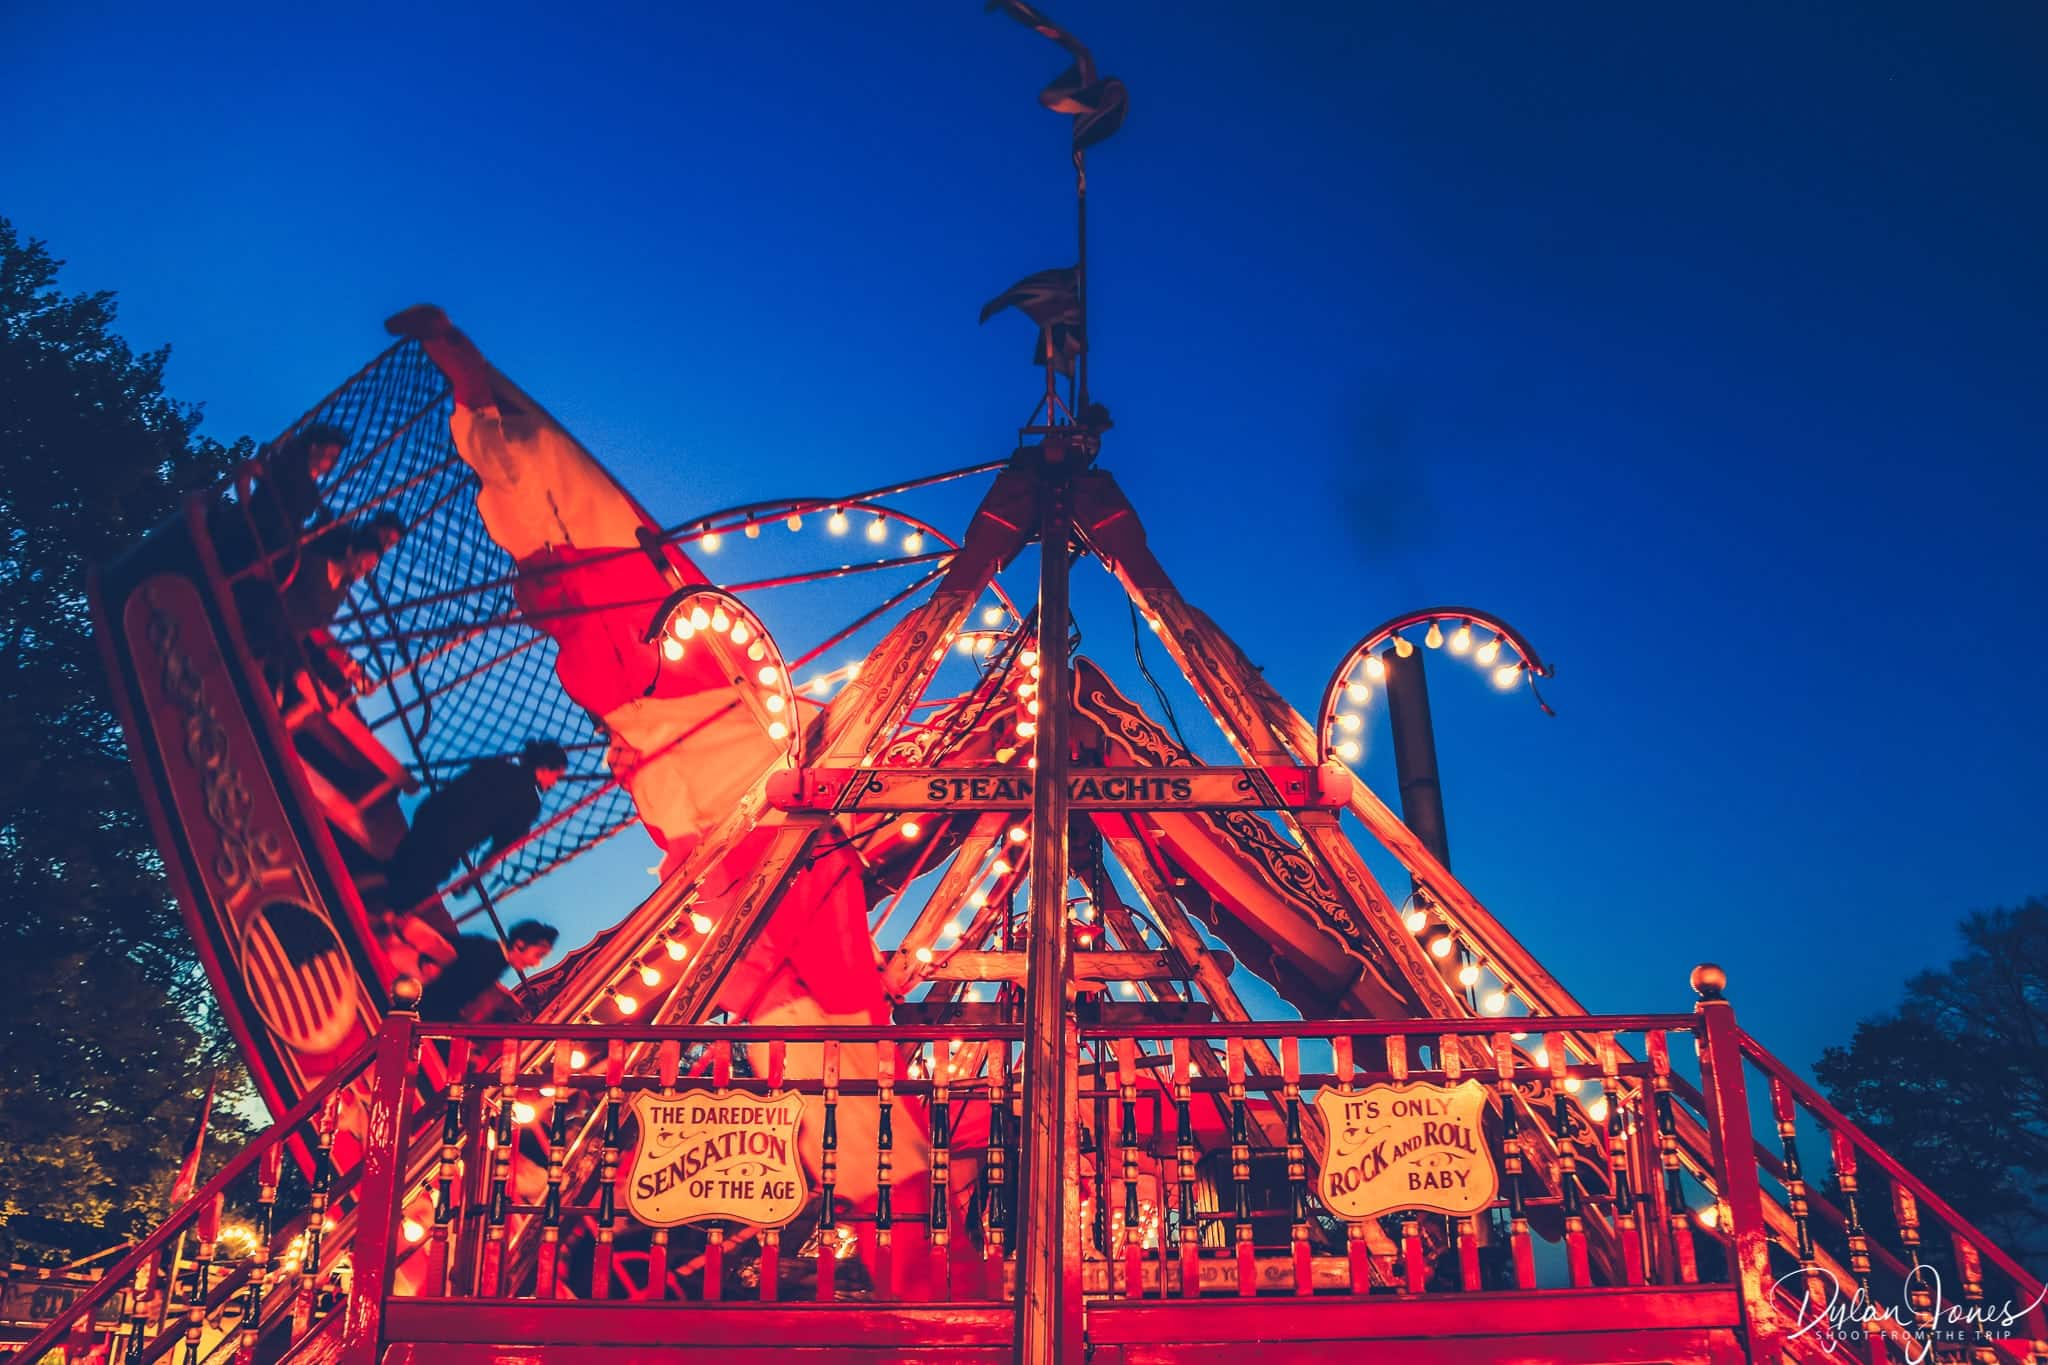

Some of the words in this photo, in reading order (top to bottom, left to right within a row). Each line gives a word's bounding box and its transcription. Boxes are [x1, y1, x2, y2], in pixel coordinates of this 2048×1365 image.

[650, 1106, 685, 1125] THE
[691, 1106, 793, 1126] DAREDEVIL
[1344, 1100, 1380, 1121] IT'S
[1391, 1098, 1454, 1118] ONLY
[636, 1130, 787, 1200] SENSATION
[1327, 1140, 1389, 1198] ROCK
[1392, 1135, 1422, 1164] AND
[1423, 1121, 1478, 1155] ROLL
[689, 1180, 715, 1199] OF
[718, 1180, 754, 1200] THE
[761, 1181, 795, 1200] AGE
[1408, 1169, 1471, 1191] BABY
